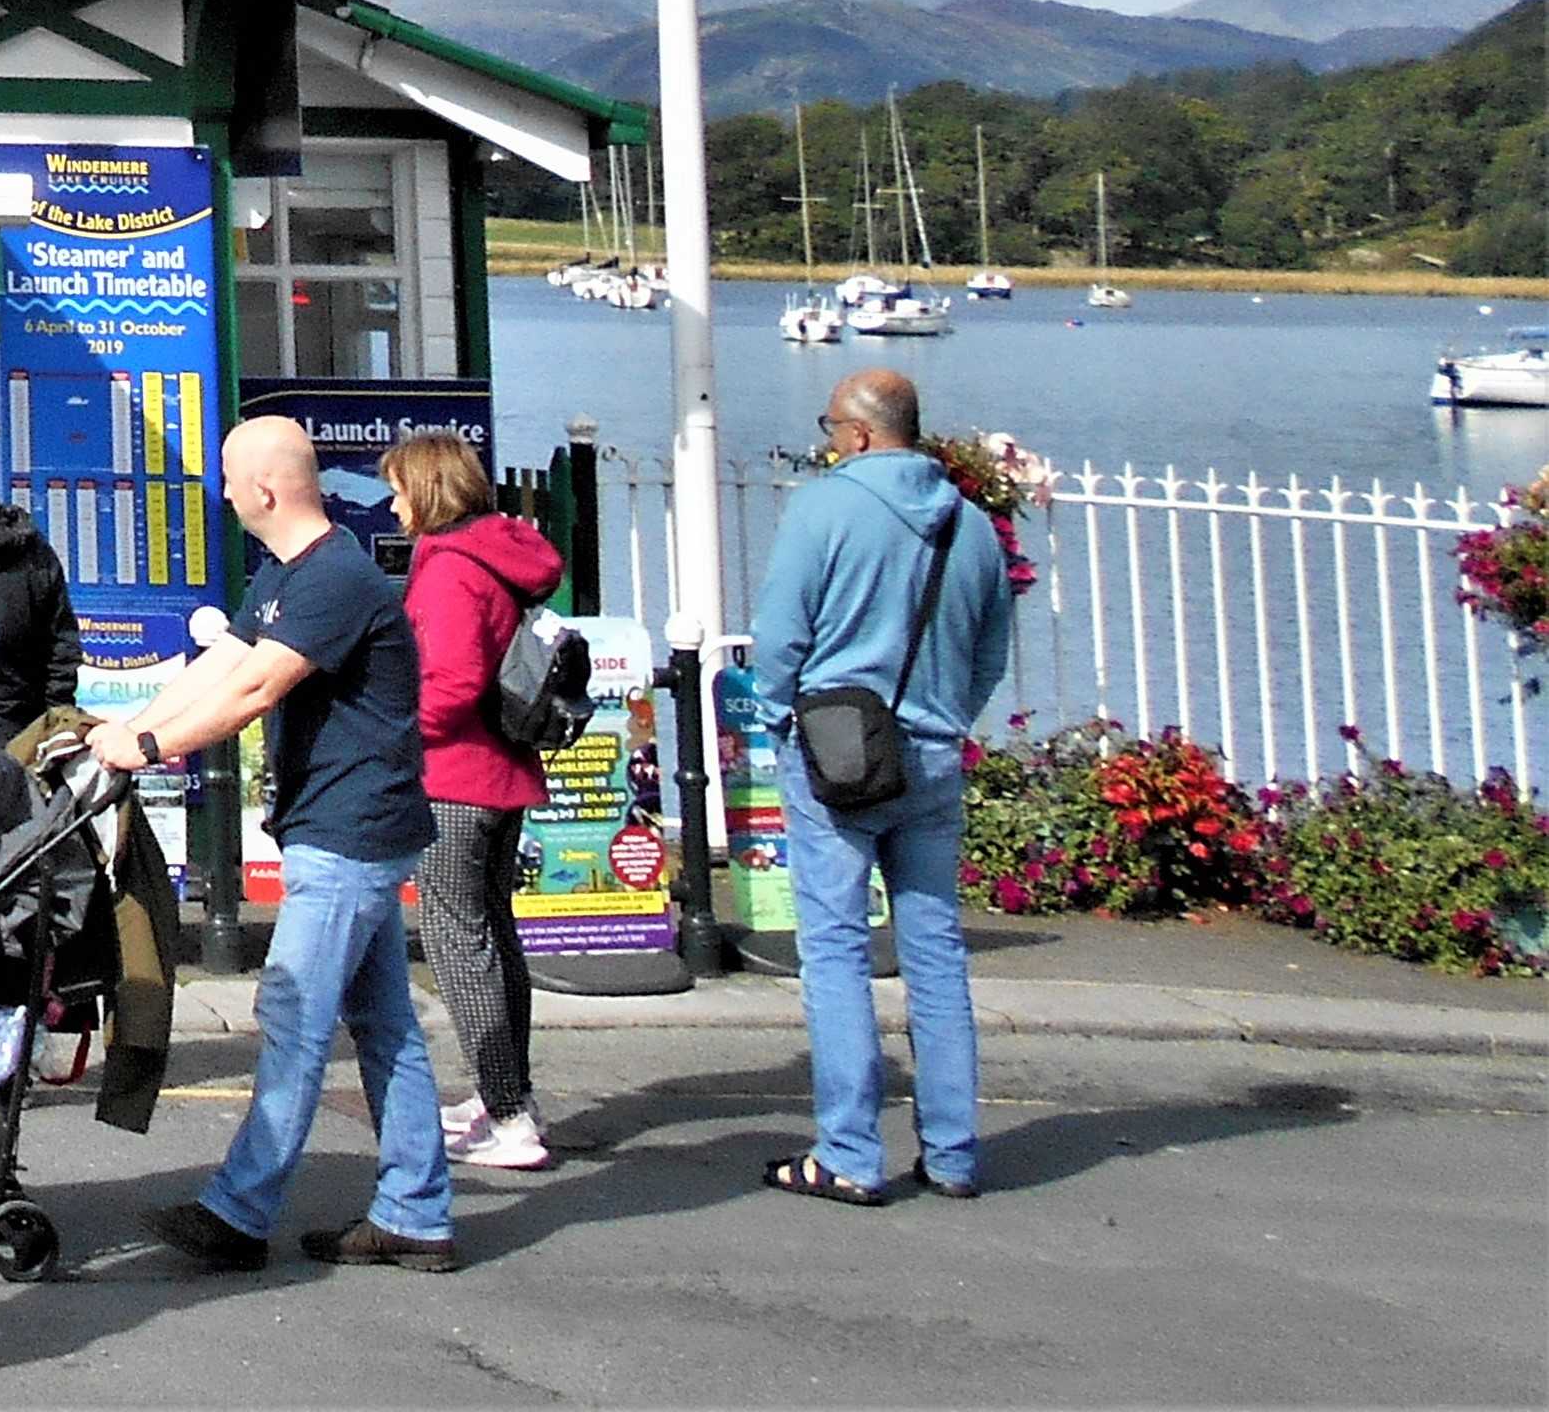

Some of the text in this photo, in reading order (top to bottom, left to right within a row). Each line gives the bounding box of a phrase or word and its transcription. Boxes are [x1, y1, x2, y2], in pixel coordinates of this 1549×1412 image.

[46, 154, 149, 175] WINDERMERE
[49, 174, 149, 186] LAKE CRUISES
[48, 204, 73, 225] the
[77, 213, 114, 231] Lake
[117, 206, 175, 231] District
[27, 241, 185, 269] 'Steamer' and
[7, 270, 207, 298] Launch Timetable
[24, 319, 186, 336] 6 April to 31 October
[87, 340, 124, 355] 2019
[305, 417, 390, 442] Launch
[122, 651, 160, 668] District
[594, 657, 628, 670] SIDE
[90, 681, 166, 700] CRUIS
